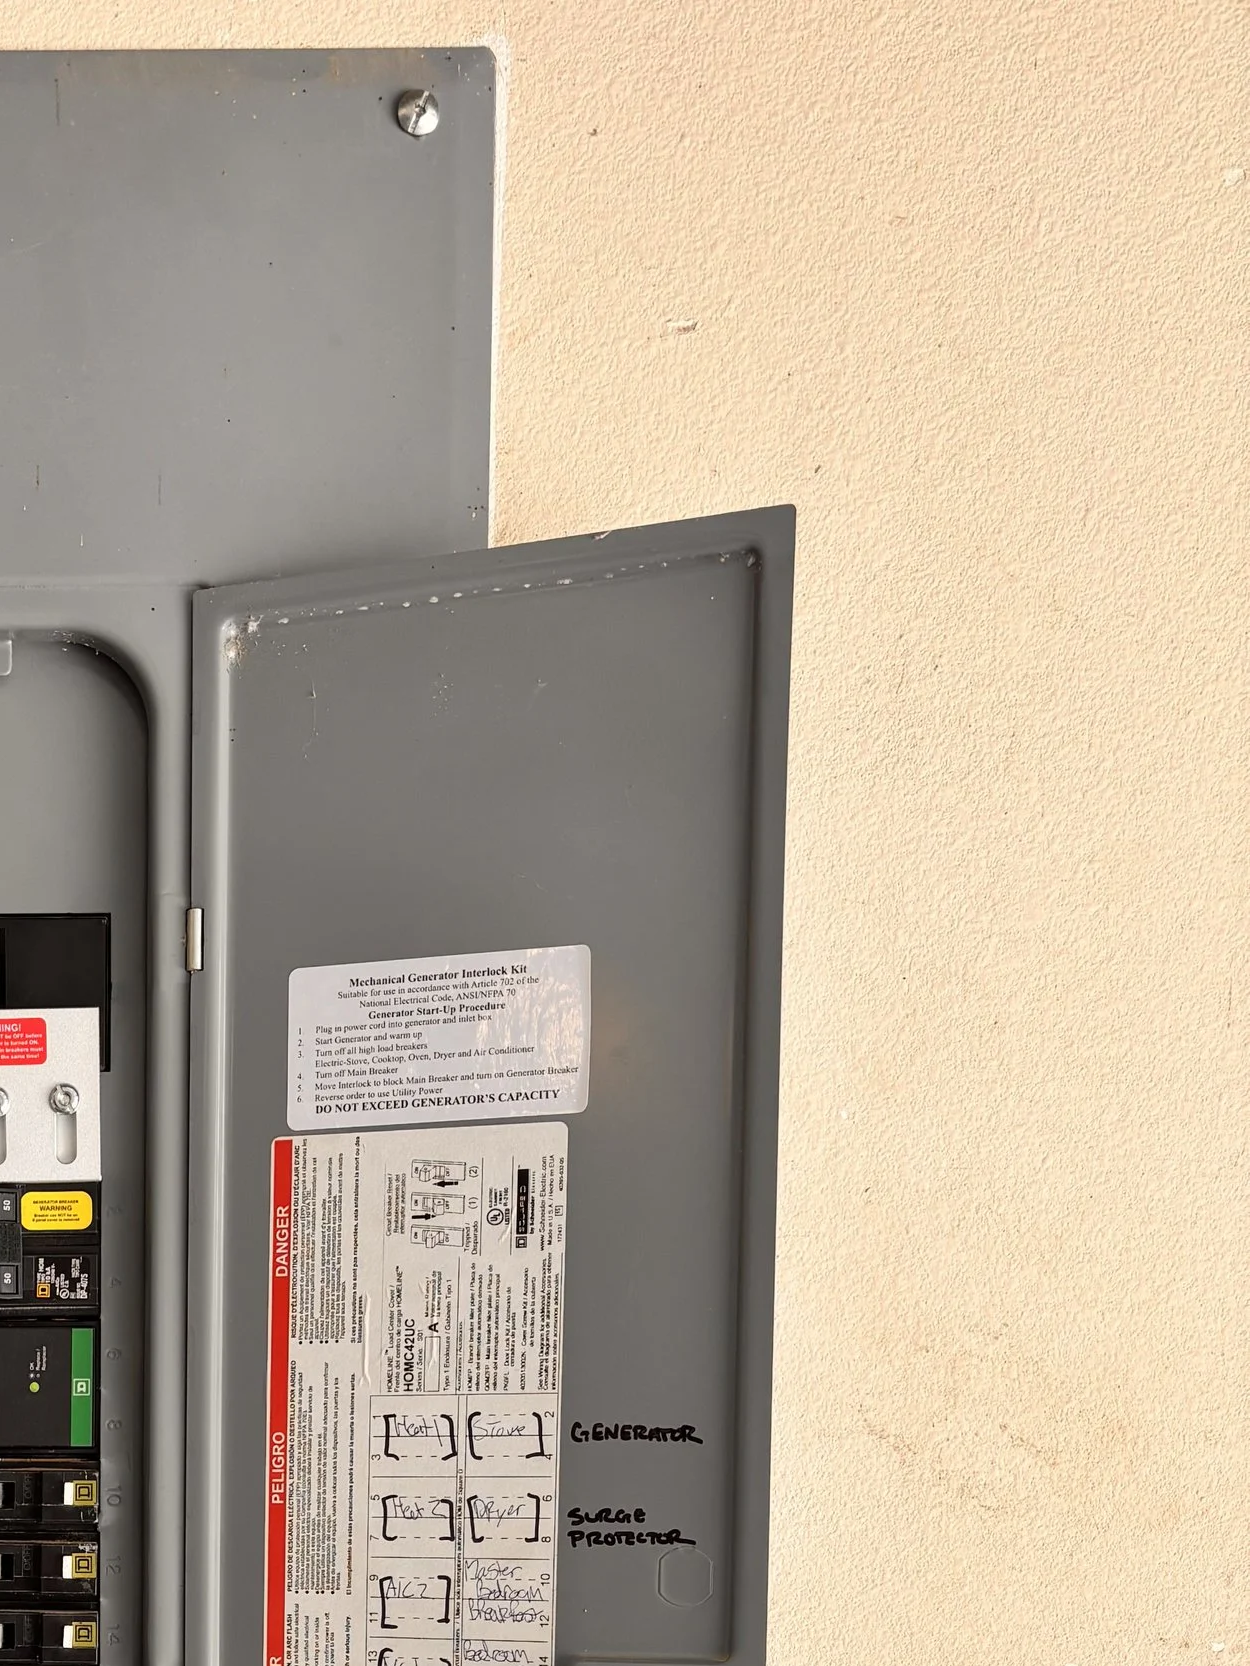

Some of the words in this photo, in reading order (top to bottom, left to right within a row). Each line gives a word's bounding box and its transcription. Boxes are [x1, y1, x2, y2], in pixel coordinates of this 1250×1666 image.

[350, 975, 405, 987] Mechanical
[408, 970, 459, 982] Generator
[462, 966, 507, 978] Interlock
[511, 965, 527, 974] Kit
[408, 984, 450, 993] accordance
[452, 982, 469, 990] with
[471, 980, 498, 988] Article
[360, 999, 391, 1008] National
[456, 990, 503, 1000] ANSI/NFPA
[369, 1008, 414, 1019] Generator
[417, 1004, 456, 1015] Start-Up
[459, 1002, 505, 1012] Procedure
[316, 1026, 332, 1034] Plug
[344, 1024, 367, 1033] power
[405, 1018, 440, 1029] generator
[413, 1031, 422, 1040] up
[316, 1059, 370, 1068] Electric-Stove,
[372, 1054, 406, 1064] Cooktop,
[408, 1053, 431, 1061] Oven,
[434, 1050, 455, 1060] Dryer
[458, 1049, 471, 1057] and
[474, 1048, 487, 1056] Air
[489, 1046, 535, 1055] Conditioner
[359, 1045, 375, 1055] high
[396, 1042, 427, 1050] breakers
[338, 1080, 371, 1088] Interlock
[383, 1077, 404, 1086] block
[406, 1076, 426, 1084] Main
[428, 1074, 458, 1082] Breaker
[461, 1072, 474, 1080] and
[507, 1068, 545, 1077] Generator
[548, 1066, 578, 1075] Breaker
[348, 1068, 367, 1076] Main
[369, 1066, 398, 1075] Breaker
[393, 1088, 416, 1097] Utility
[419, 1087, 443, 1095] Power
[316, 1105, 331, 1114] DO
[335, 1103, 360, 1113] NOT
[362, 1100, 408, 1111] EXCEED
[412, 1094, 495, 1107] GENERATOR'S
[498, 1089, 560, 1102] CAPACITY
[3, 1200, 11, 1211] 50
[275, 1206, 289, 1277] DANGER
[4, 1272, 11, 1284] 50
[404, 1318, 415, 1392] HOMC42UC
[571, 1422, 703, 1444] GENERATOR
[272, 1432, 285, 1504] PELIGRO
[568, 1508, 645, 1525] SURGE
[568, 1529, 696, 1547] PROTECTOR
